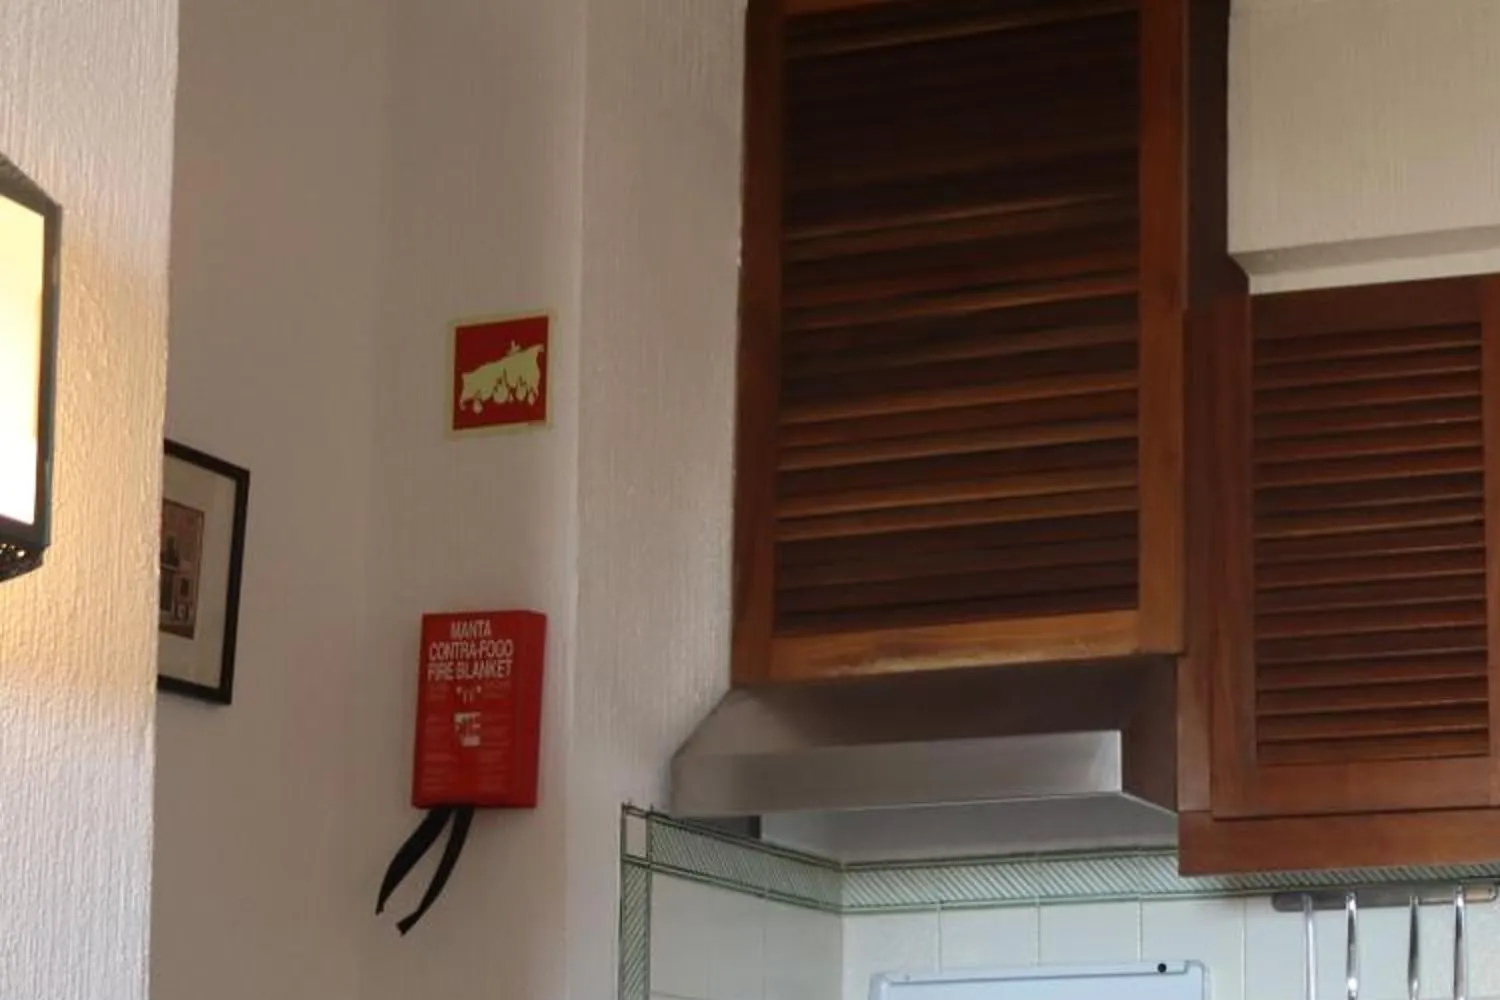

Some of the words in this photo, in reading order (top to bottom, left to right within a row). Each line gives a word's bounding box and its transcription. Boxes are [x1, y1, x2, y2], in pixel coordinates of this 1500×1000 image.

[450, 620, 492, 638] MANTA
[427, 661, 454, 681] FIRE
[455, 659, 513, 680] BLANKET
